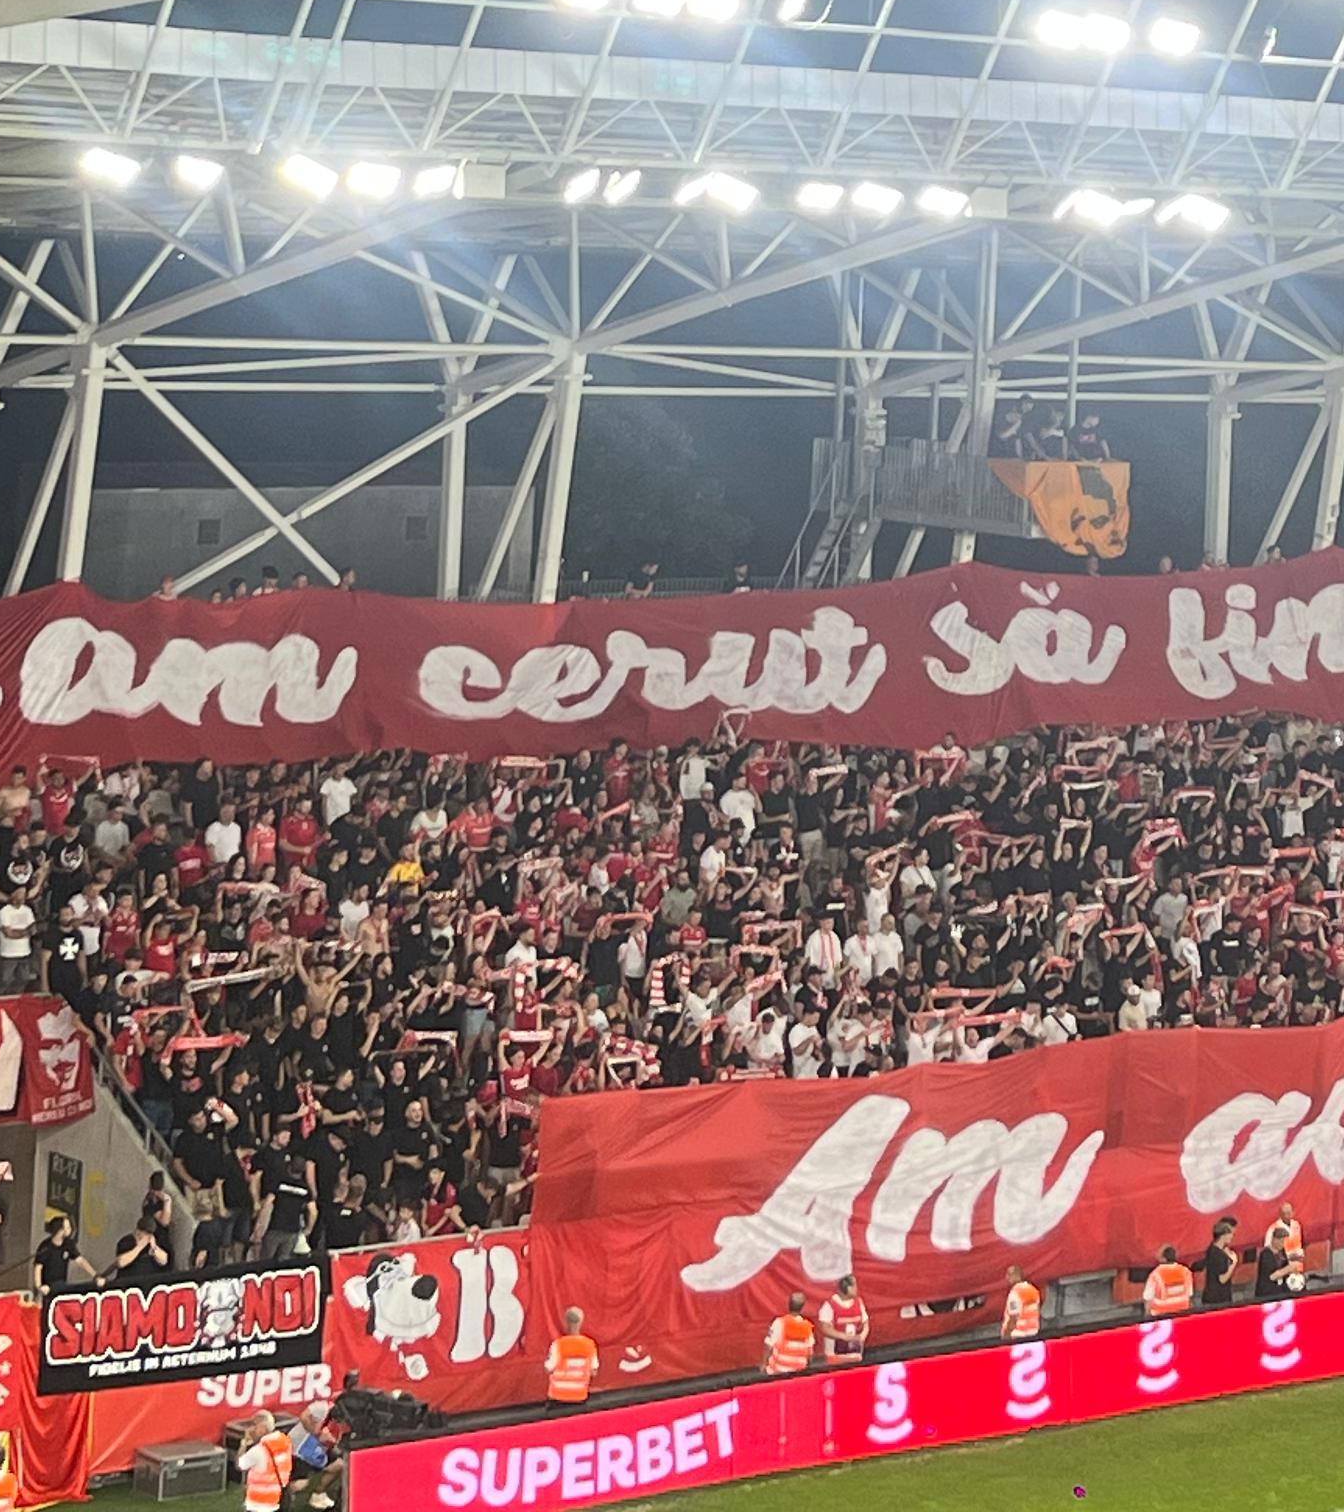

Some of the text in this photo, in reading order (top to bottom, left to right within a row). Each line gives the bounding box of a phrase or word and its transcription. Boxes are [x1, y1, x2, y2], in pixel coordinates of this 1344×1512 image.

[417, 606, 887, 722] cerut
[922, 581, 1126, 695] să
[680, 1094, 1104, 1292] Am
[47, 1266, 320, 1364] SIAMO NOI
[449, 1245, 525, 1361] B
[438, 1399, 741, 1507] SUPERBET
